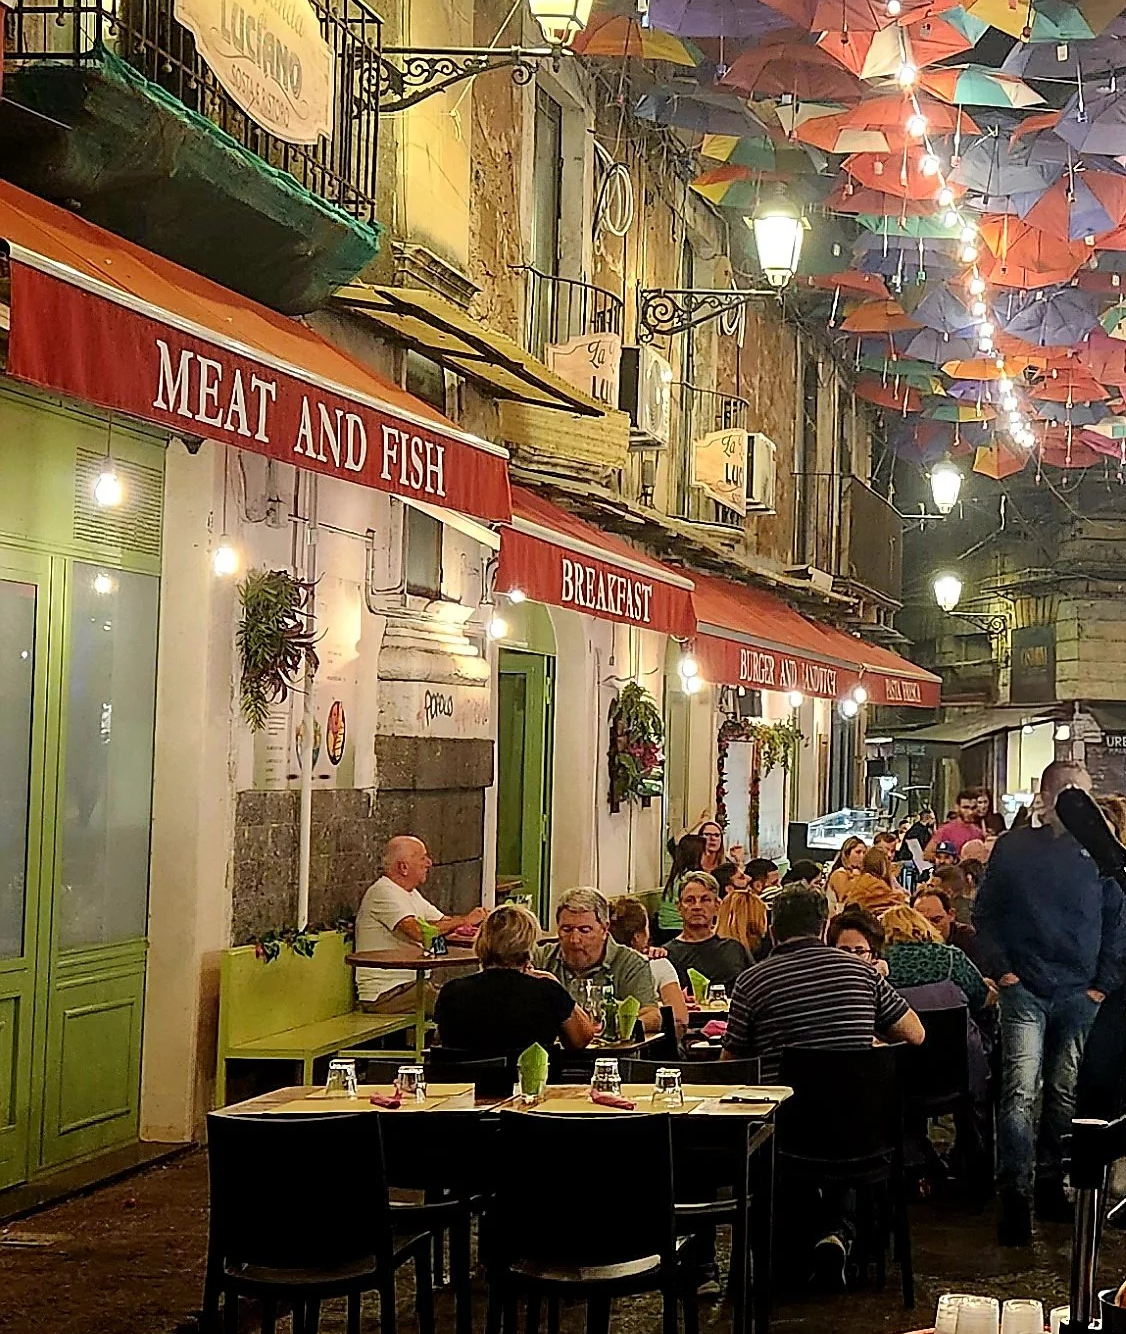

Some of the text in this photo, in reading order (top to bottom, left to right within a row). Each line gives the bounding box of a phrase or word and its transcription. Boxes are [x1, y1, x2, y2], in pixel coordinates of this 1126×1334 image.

[153, 339, 447, 499] MEAT AND FISH
[560, 557, 654, 624] BREAKFAST
[739, 648, 775, 685] BURGER
[779, 658, 798, 689] AND
